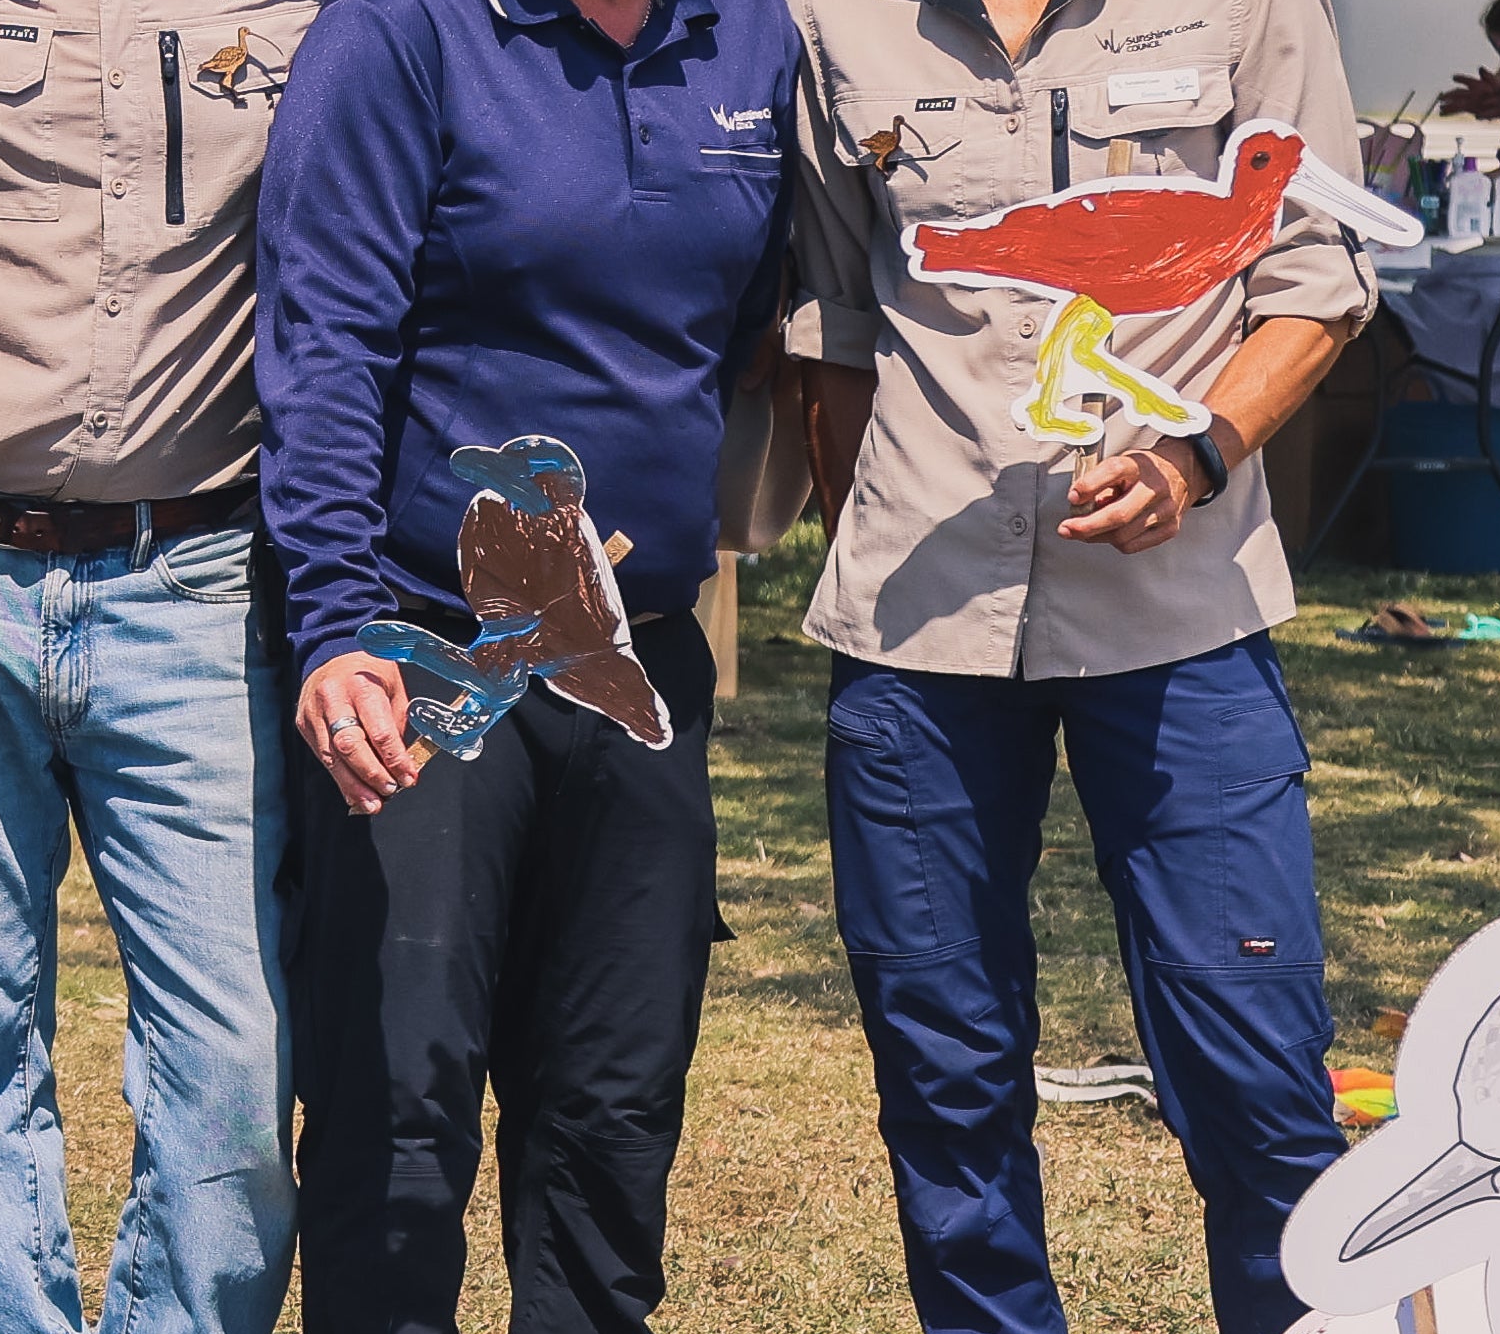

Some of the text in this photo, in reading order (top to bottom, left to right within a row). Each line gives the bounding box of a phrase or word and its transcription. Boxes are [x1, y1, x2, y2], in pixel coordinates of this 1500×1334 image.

[1125, 20, 1206, 45] Sunshine Coast
[1126, 40, 1162, 53] COUNCIL
